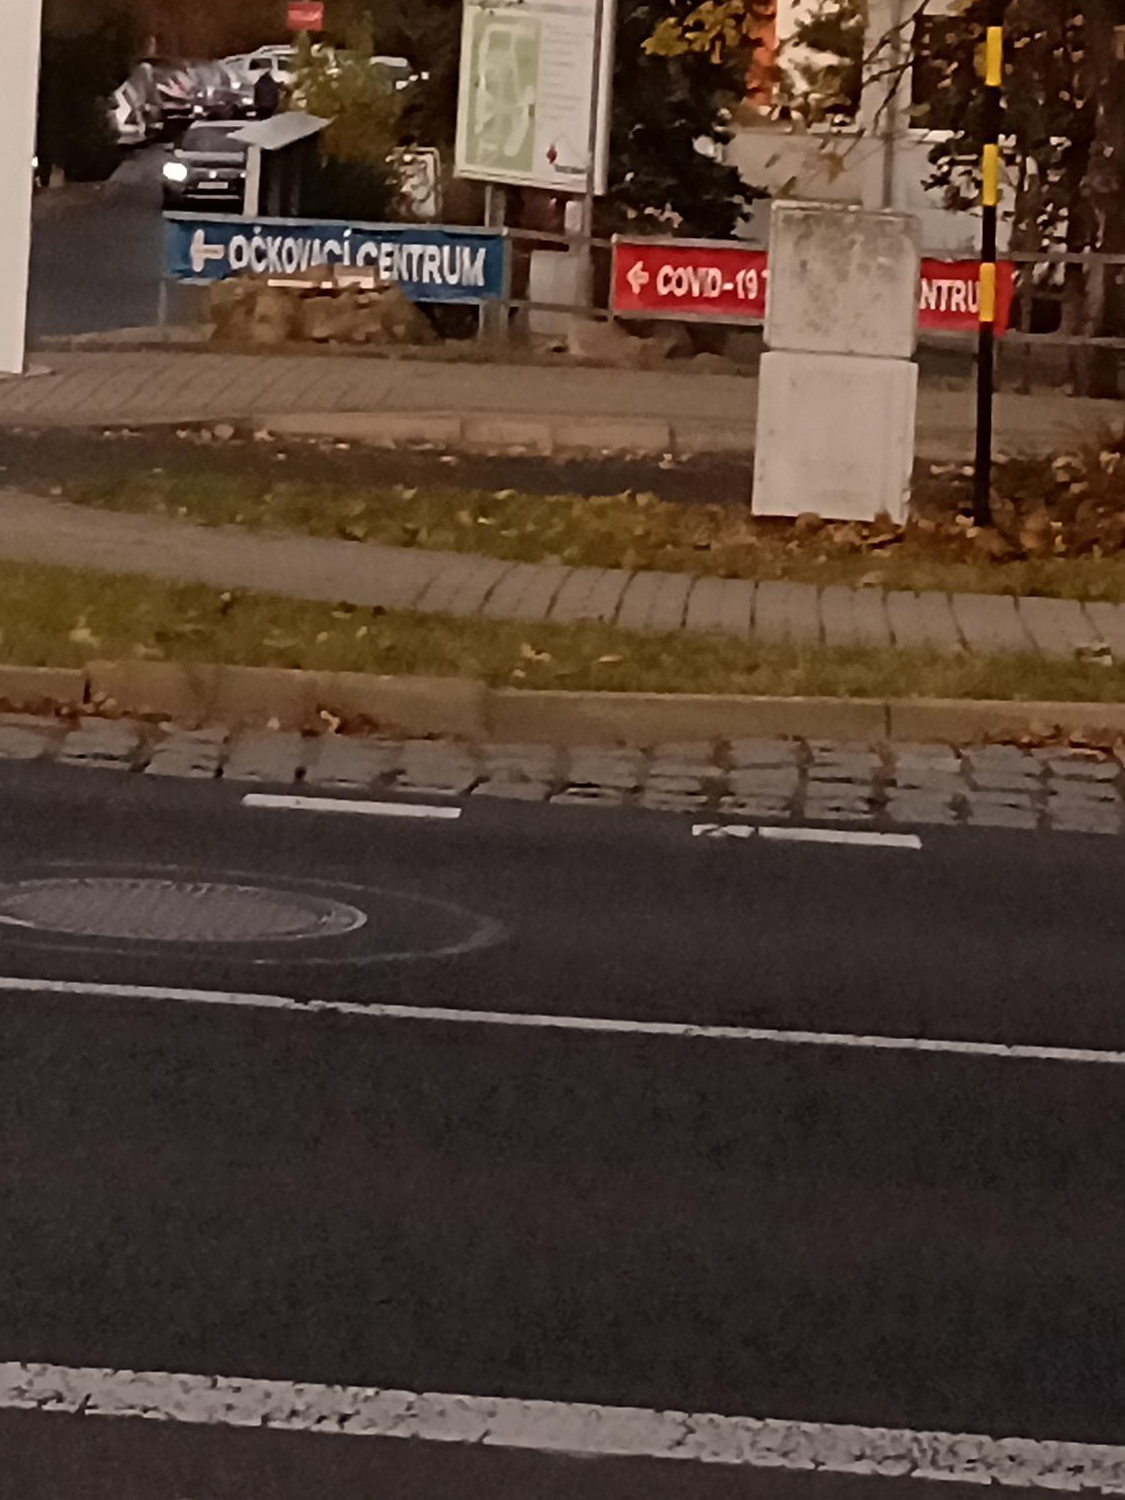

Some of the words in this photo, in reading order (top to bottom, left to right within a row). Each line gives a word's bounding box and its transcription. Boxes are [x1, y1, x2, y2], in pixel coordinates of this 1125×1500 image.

[228, 226, 350, 273] OČKOVACÍ
[357, 240, 486, 287] CENTRUM
[656, 264, 758, 300] COVID-19
[919, 278, 980, 313] NTRU
